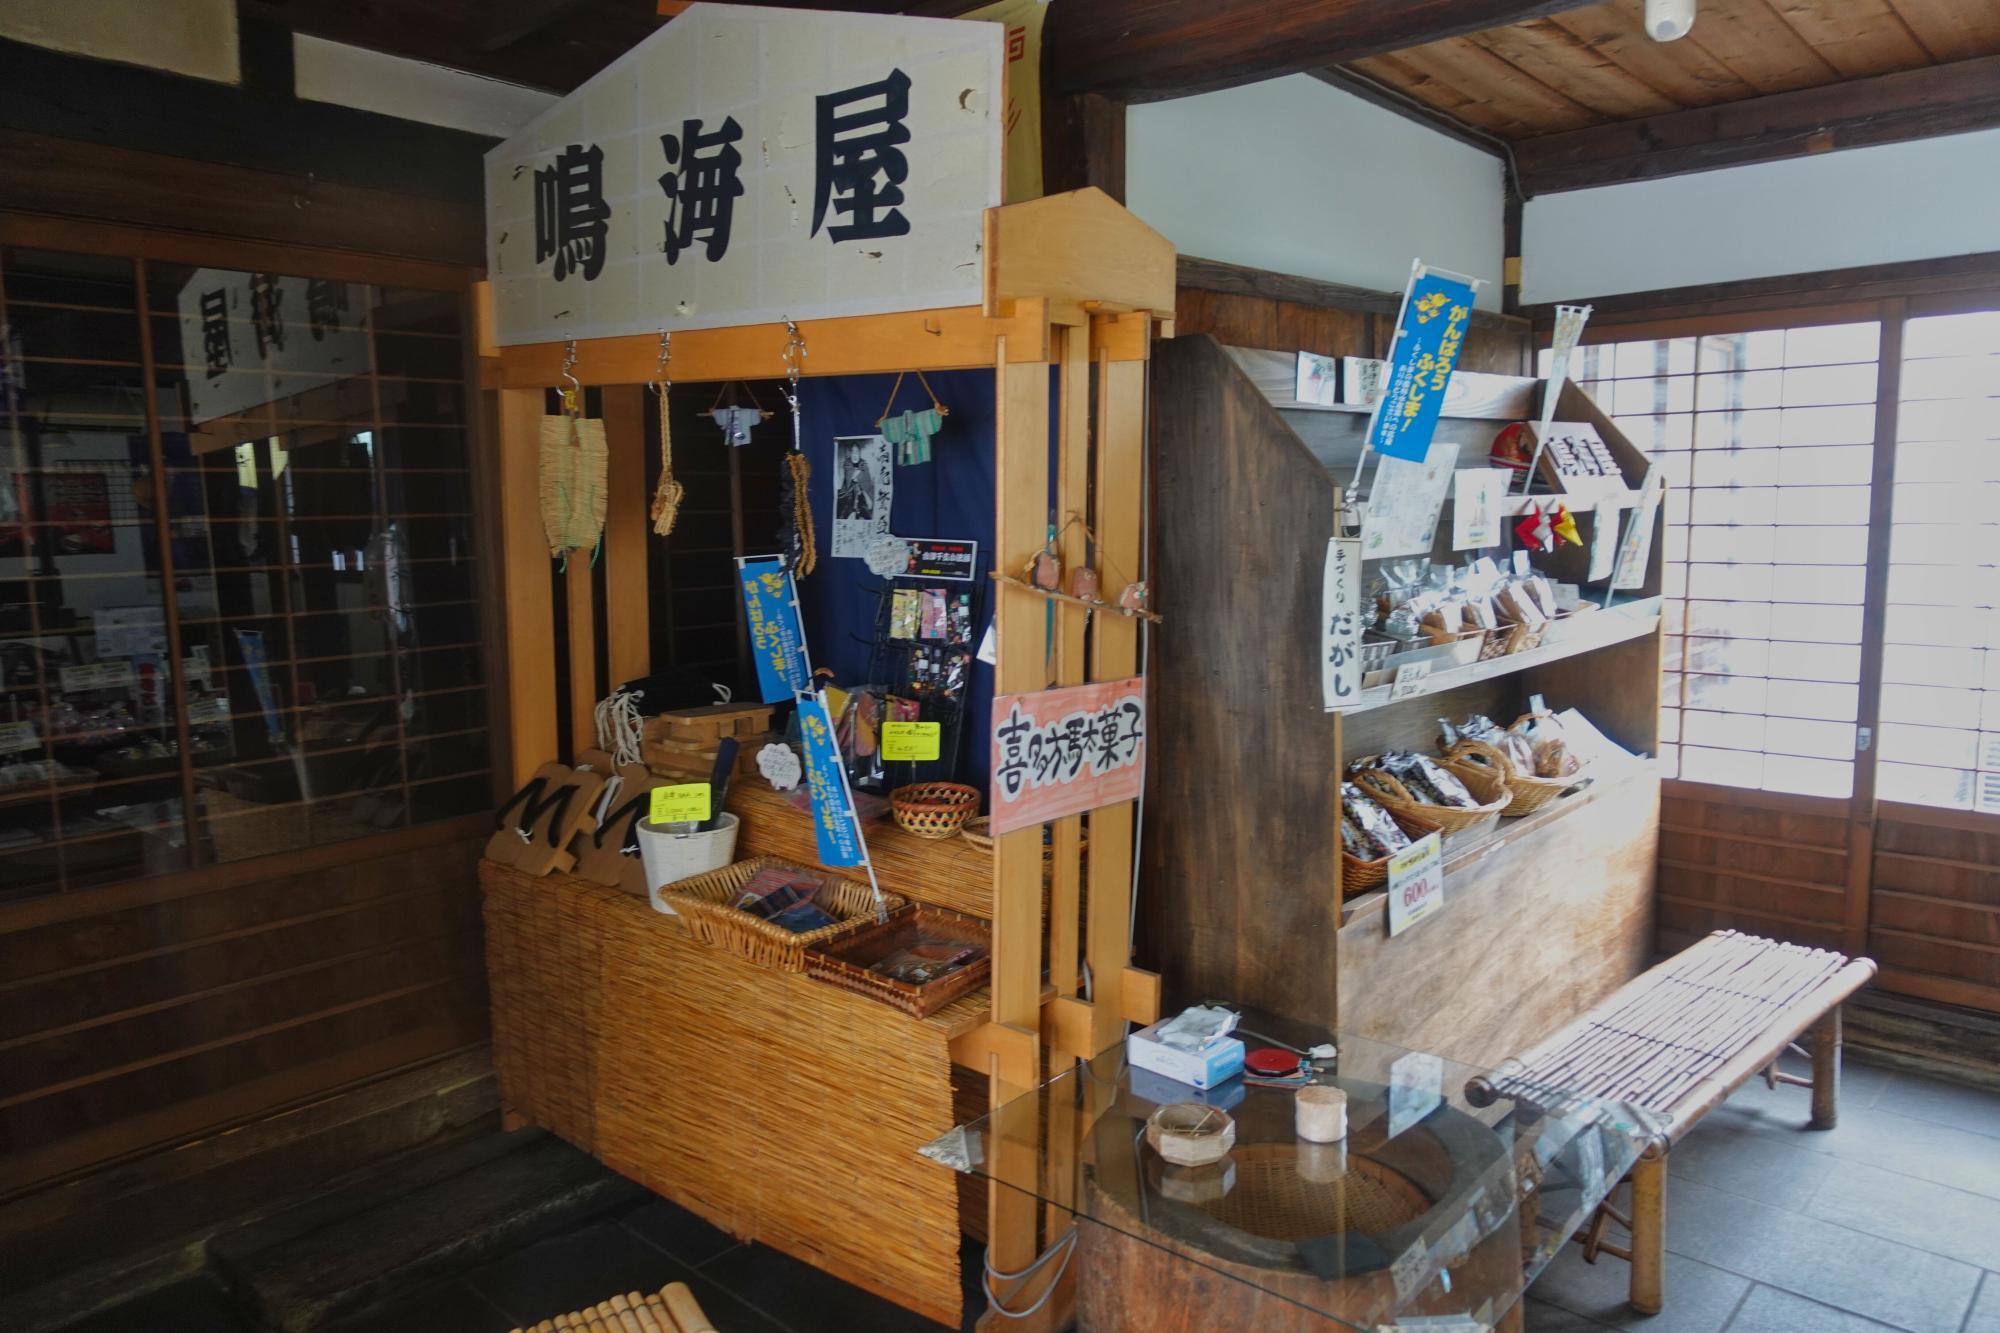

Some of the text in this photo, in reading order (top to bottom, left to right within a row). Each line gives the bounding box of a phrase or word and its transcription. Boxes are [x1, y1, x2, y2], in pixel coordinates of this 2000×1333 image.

[534, 68, 912, 281] 鳴海屋
[1431, 304, 1469, 392] がんばろう
[997, 703, 1143, 793] 喜多方駄菓子
